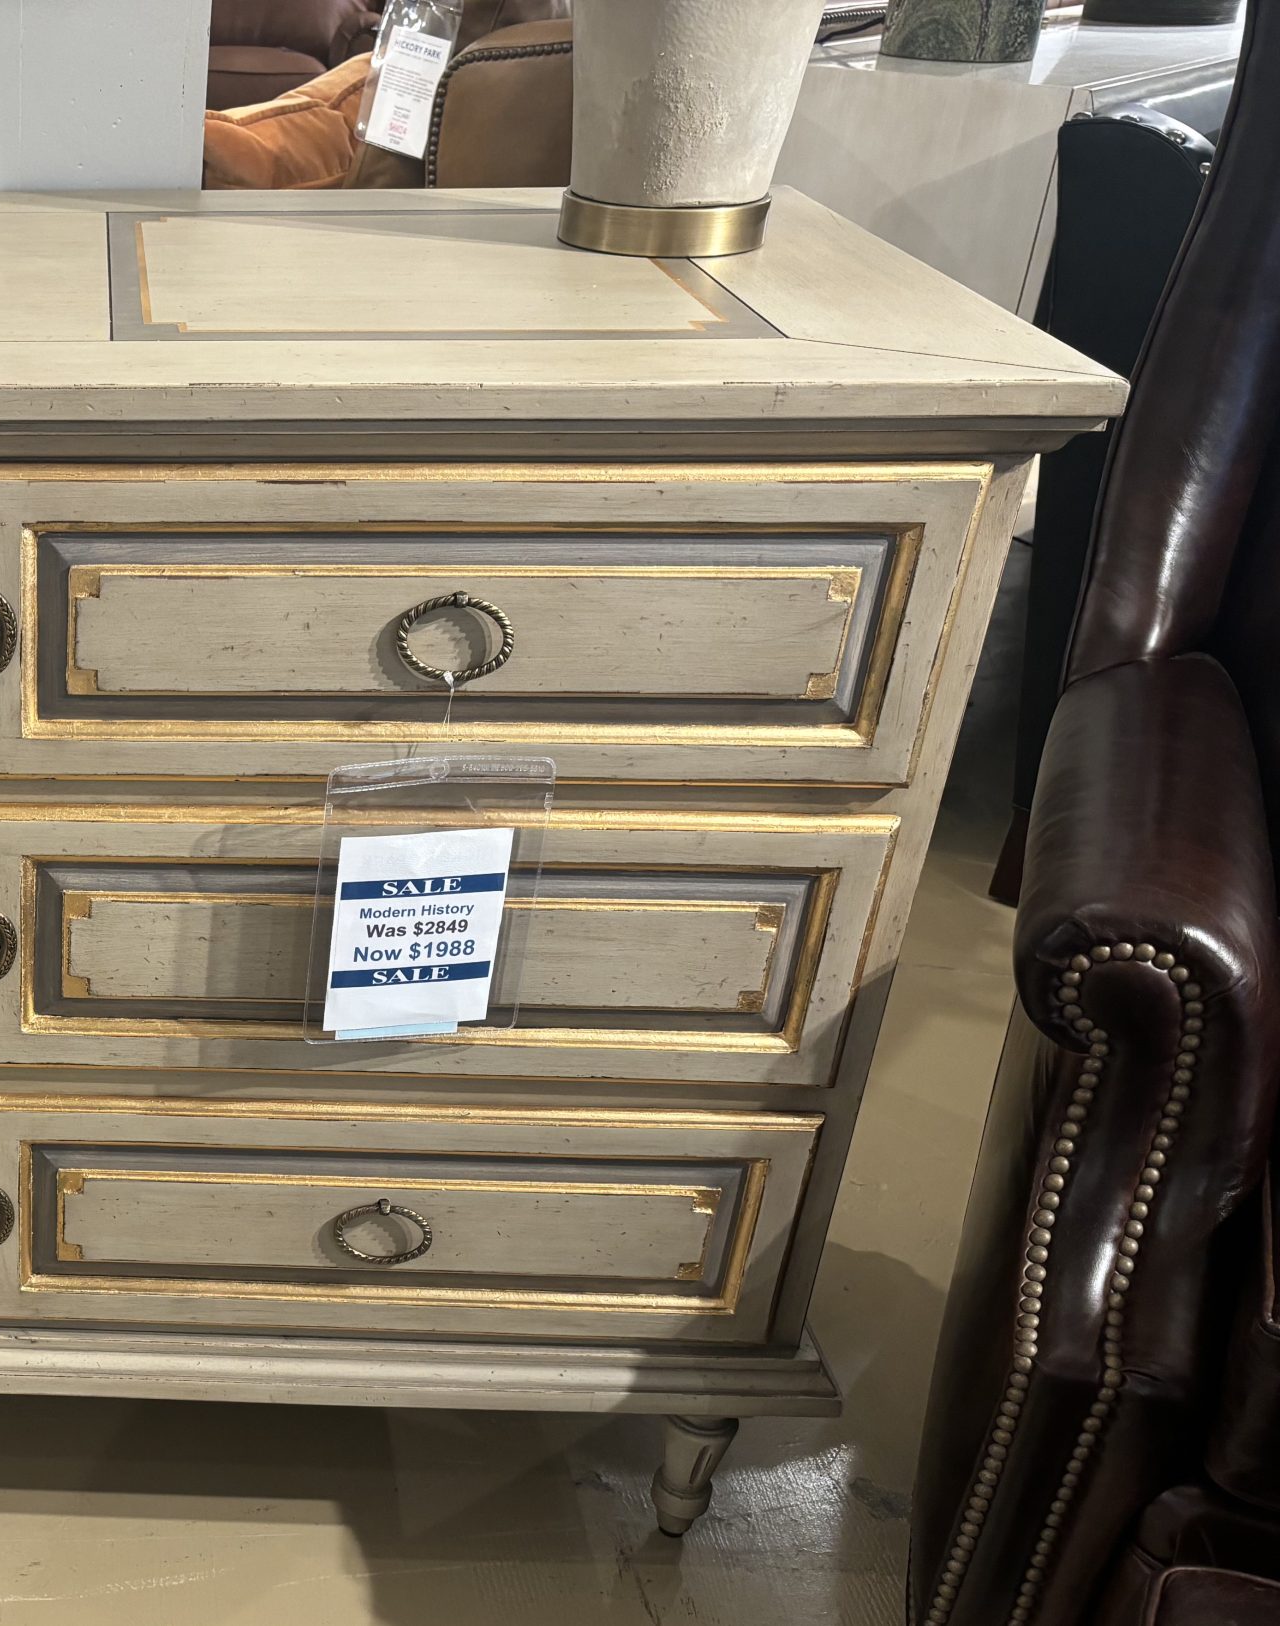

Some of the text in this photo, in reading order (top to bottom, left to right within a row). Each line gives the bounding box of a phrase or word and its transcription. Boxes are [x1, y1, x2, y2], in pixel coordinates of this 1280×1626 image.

[423, 46, 442, 60] PARK
[382, 878, 462, 896] SALE
[359, 904, 475, 919] Modern History
[366, 919, 469, 938] Was $2849
[353, 939, 476, 962] Now $1988
[372, 966, 450, 985] SALE
